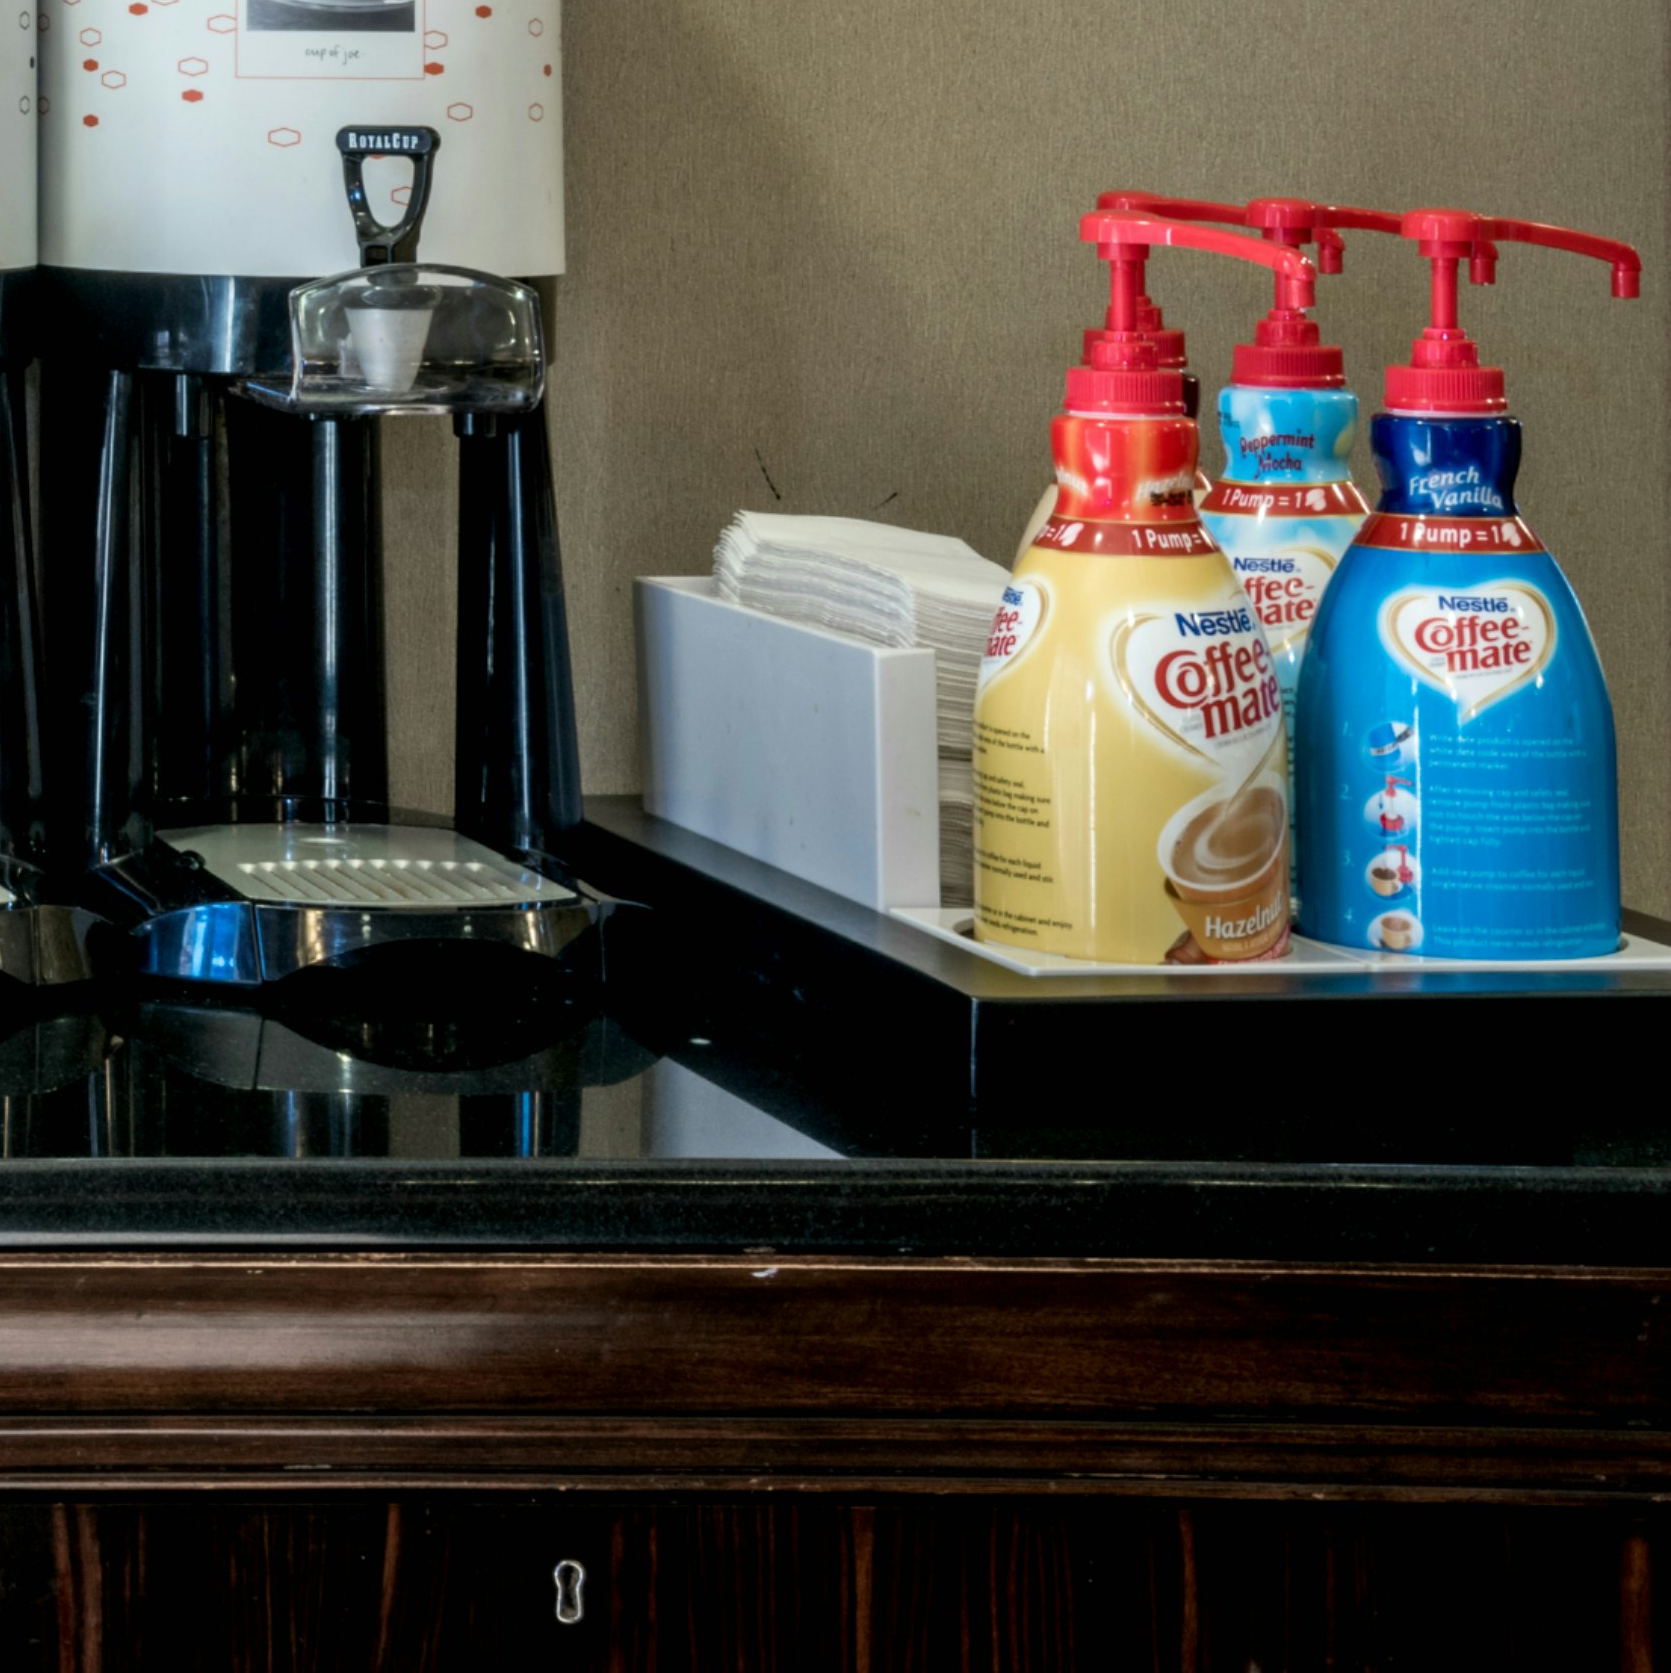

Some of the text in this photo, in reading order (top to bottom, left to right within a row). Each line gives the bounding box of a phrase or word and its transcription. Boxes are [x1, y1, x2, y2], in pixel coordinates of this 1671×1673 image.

[305, 48, 327, 61] cup
[329, 43, 341, 58] of
[1240, 429, 1314, 458] Peppermint
[1254, 452, 1302, 479] Mocha
[1410, 465, 1480, 496] French
[1222, 488, 1231, 505] 1
[1230, 488, 1274, 509] Pump
[1295, 492, 1303, 508] 1
[1430, 486, 1503, 510] Vanilla
[1132, 530, 1142, 548] 1
[1400, 522, 1408, 540] 1
[1414, 522, 1472, 548] Pump
[1491, 525, 1499, 544] 1
[1244, 575, 1314, 605] ffee-
[1256, 599, 1314, 625] ate
[1414, 615, 1529, 654] Coffee-
[1446, 640, 1531, 672] mate
[1201, 675, 1280, 739] mate
